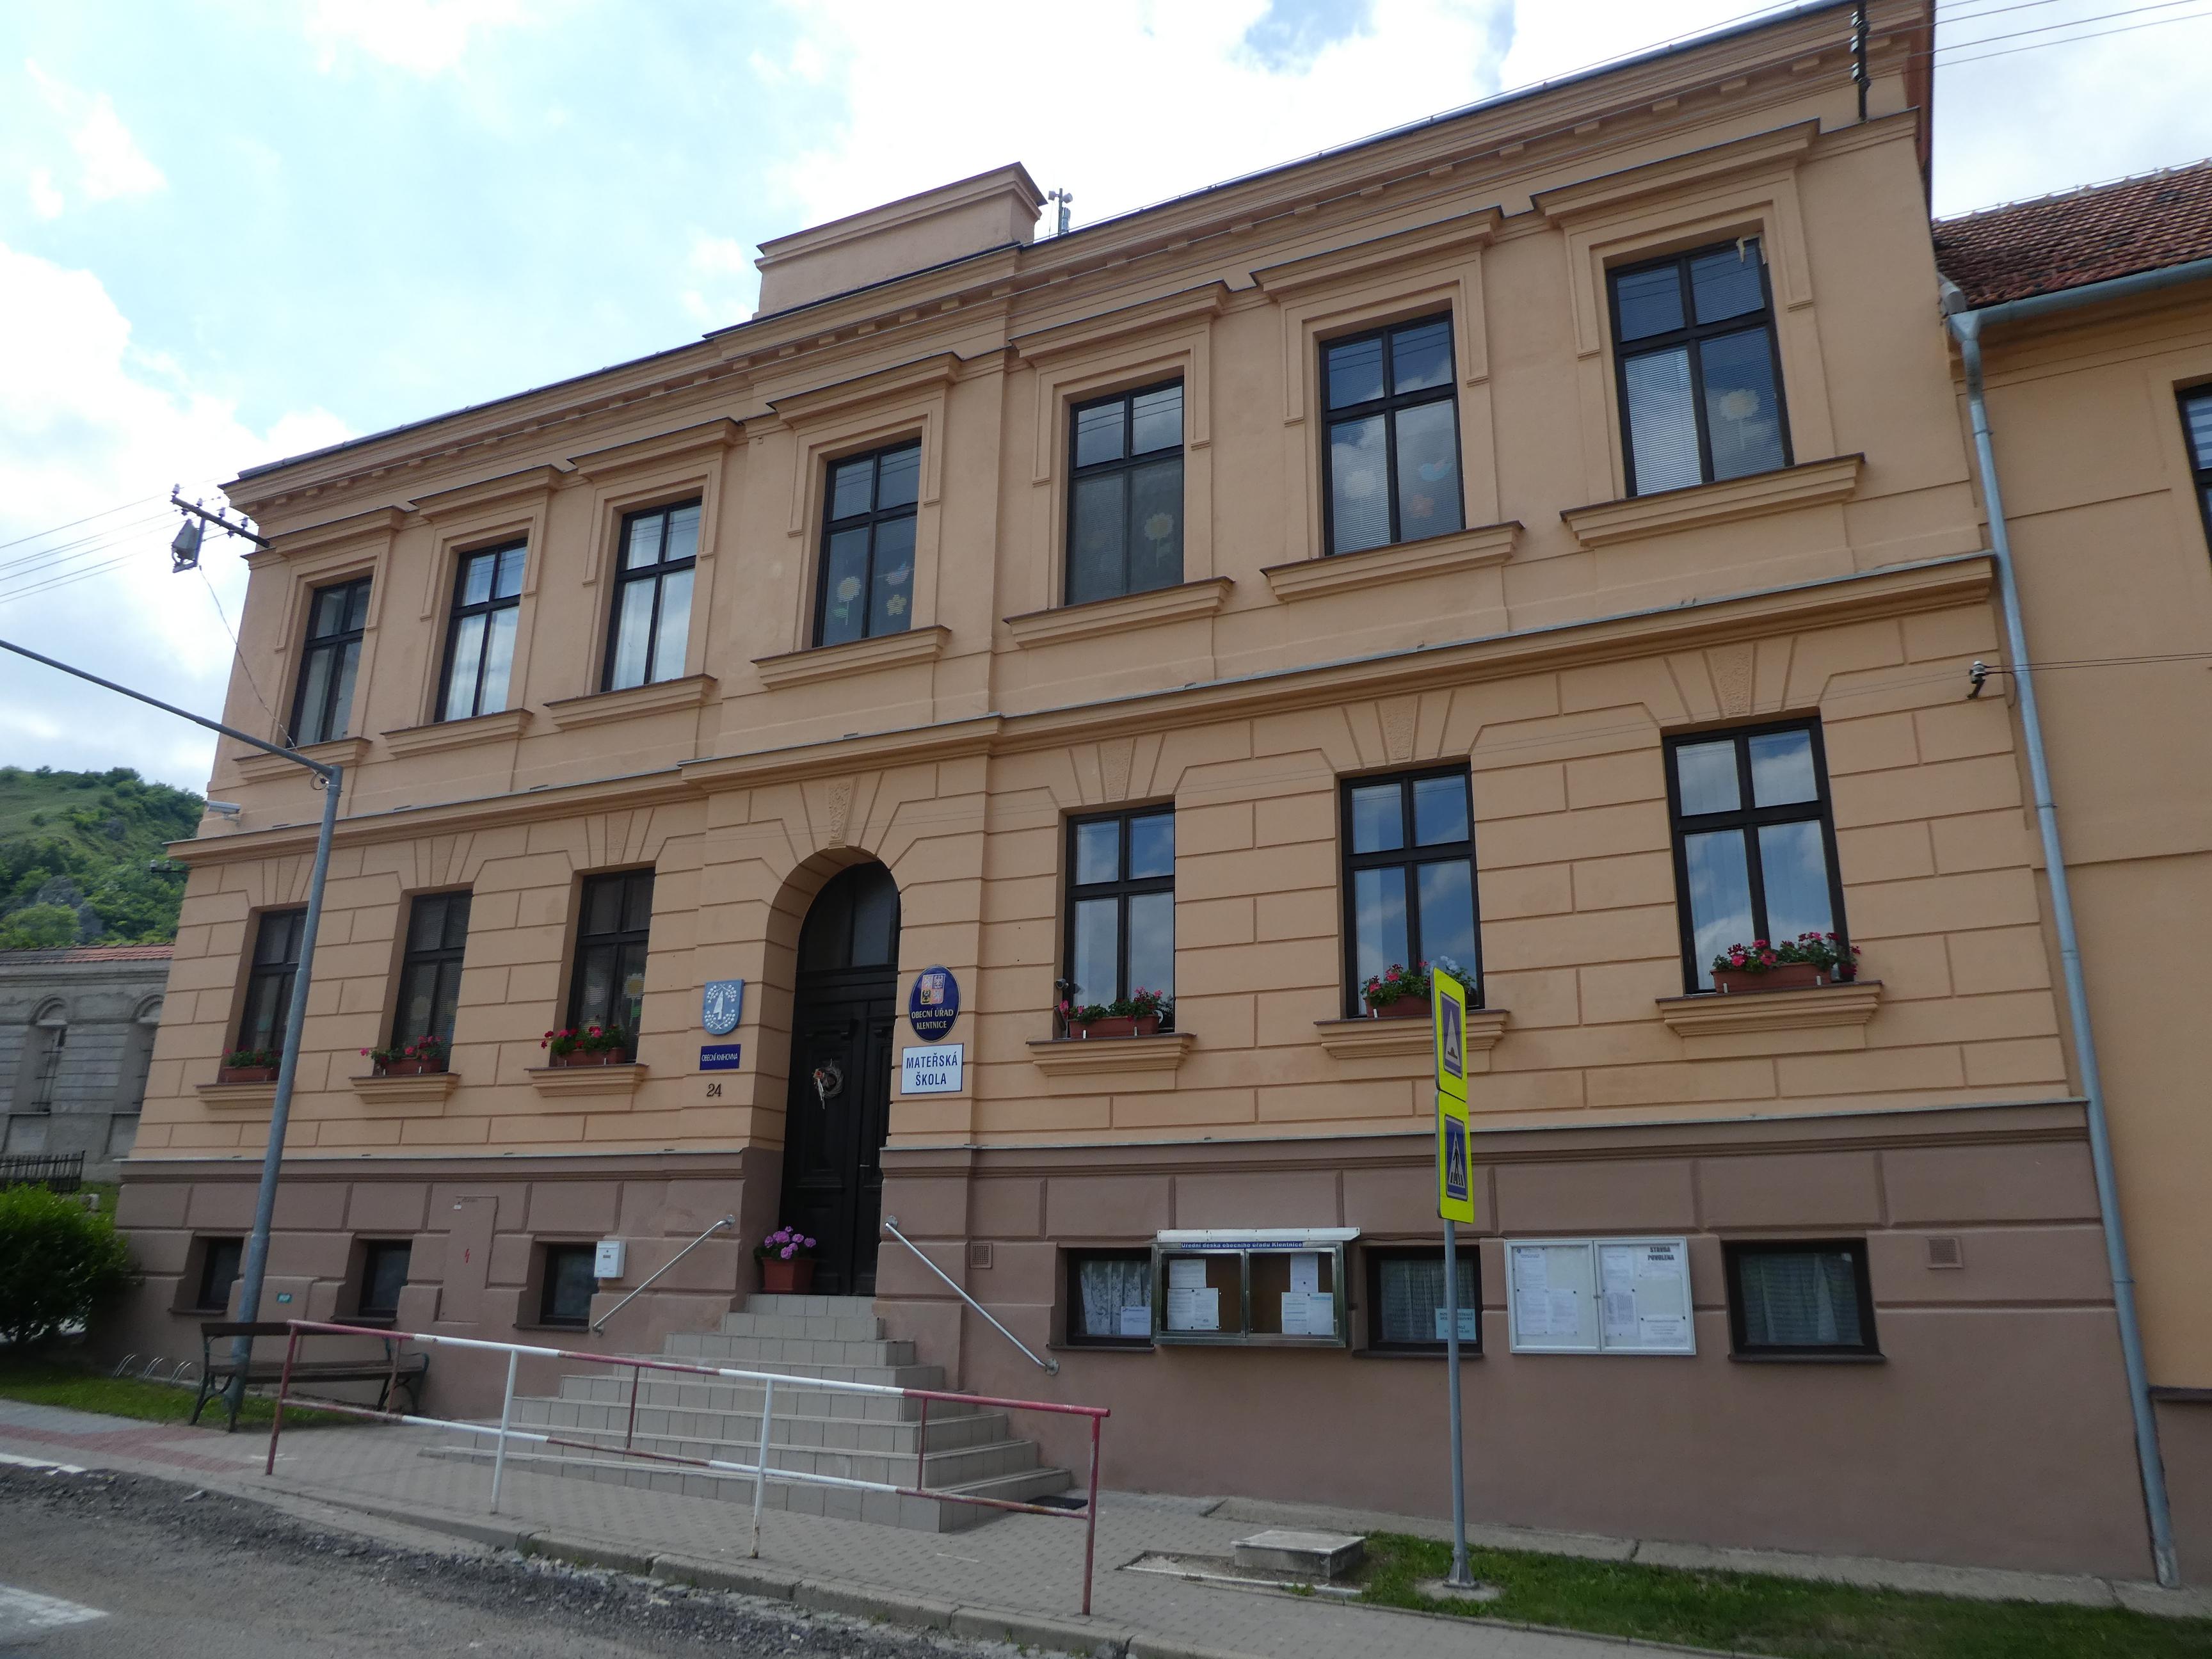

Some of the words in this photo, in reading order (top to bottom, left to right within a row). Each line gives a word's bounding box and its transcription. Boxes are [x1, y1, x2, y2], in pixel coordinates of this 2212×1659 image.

[911, 1009, 933, 1018] OBECNÍ
[934, 1007, 954, 1017] ÚŘAD
[917, 1021, 947, 1030] KLENTNICE
[701, 1053, 716, 1061] OBECNÍ
[906, 1052, 958, 1069] MATEŘSKÁ
[915, 1071, 947, 1086] ŠKOLA
[706, 1083, 723, 1097] 24
